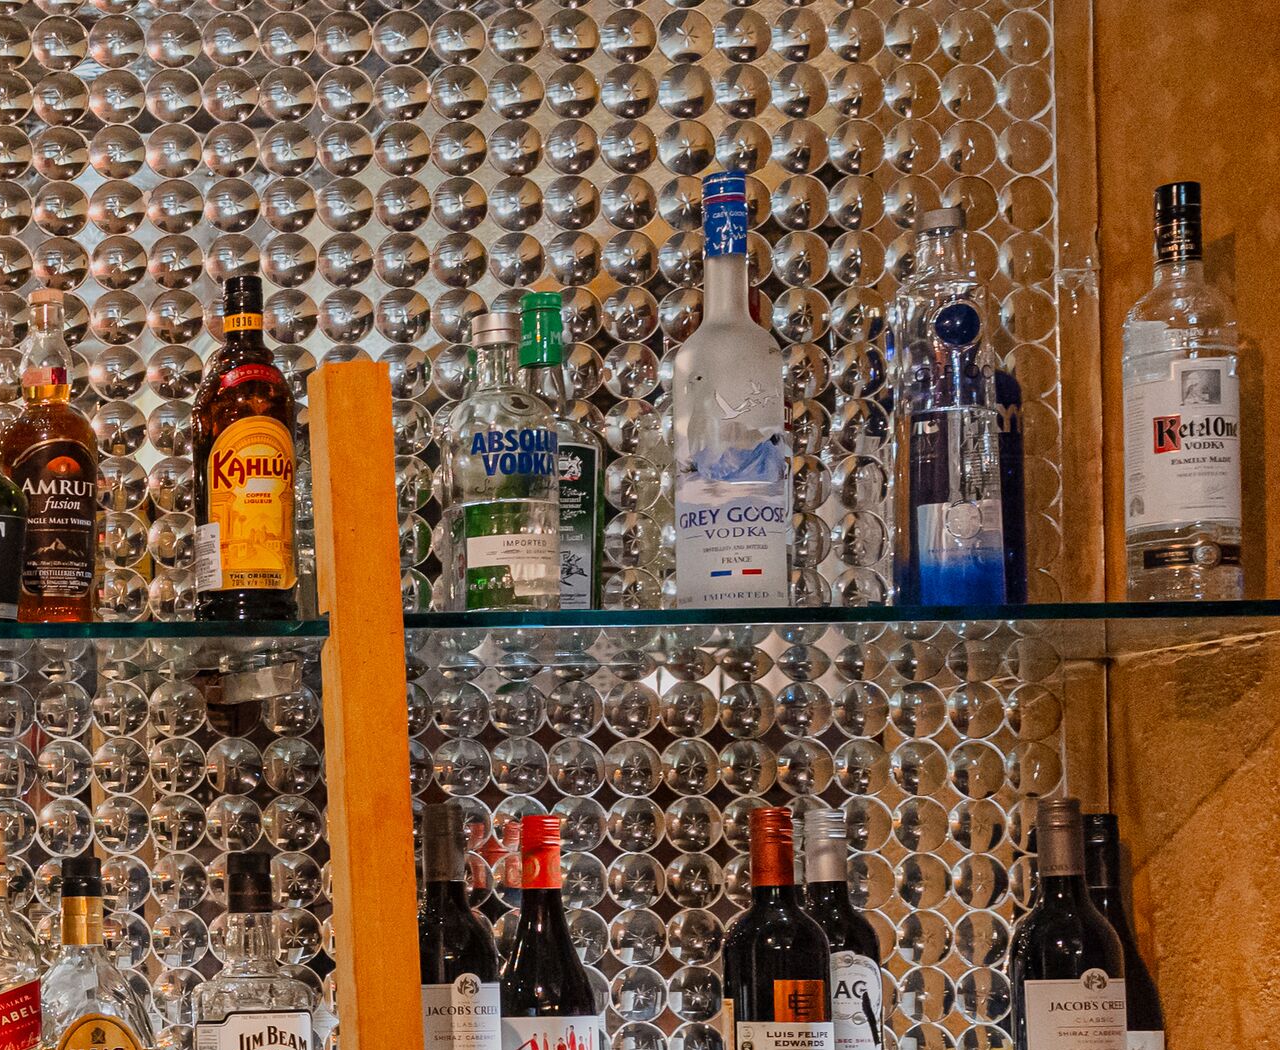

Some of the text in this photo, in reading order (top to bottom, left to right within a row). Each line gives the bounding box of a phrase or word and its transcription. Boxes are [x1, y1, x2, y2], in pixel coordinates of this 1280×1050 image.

[232, 316, 252, 327] 1936
[1184, 441, 1225, 450] VODKA
[482, 453, 556, 476] VODKA
[1171, 457, 1208, 465] FAMILY
[213, 450, 293, 489] KAHLÚA
[22, 478, 95, 497] AMRUT
[40, 496, 80, 513] fusion
[680, 506, 784, 529] GREY GOOSE
[705, 526, 767, 539] VODKA
[721, 556, 753, 564] FRANCE
[704, 591, 770, 601] IMPORTED
[426, 1004, 471, 1016] JACOB'S
[1048, 1000, 1125, 1012] JACOB'S CREE
